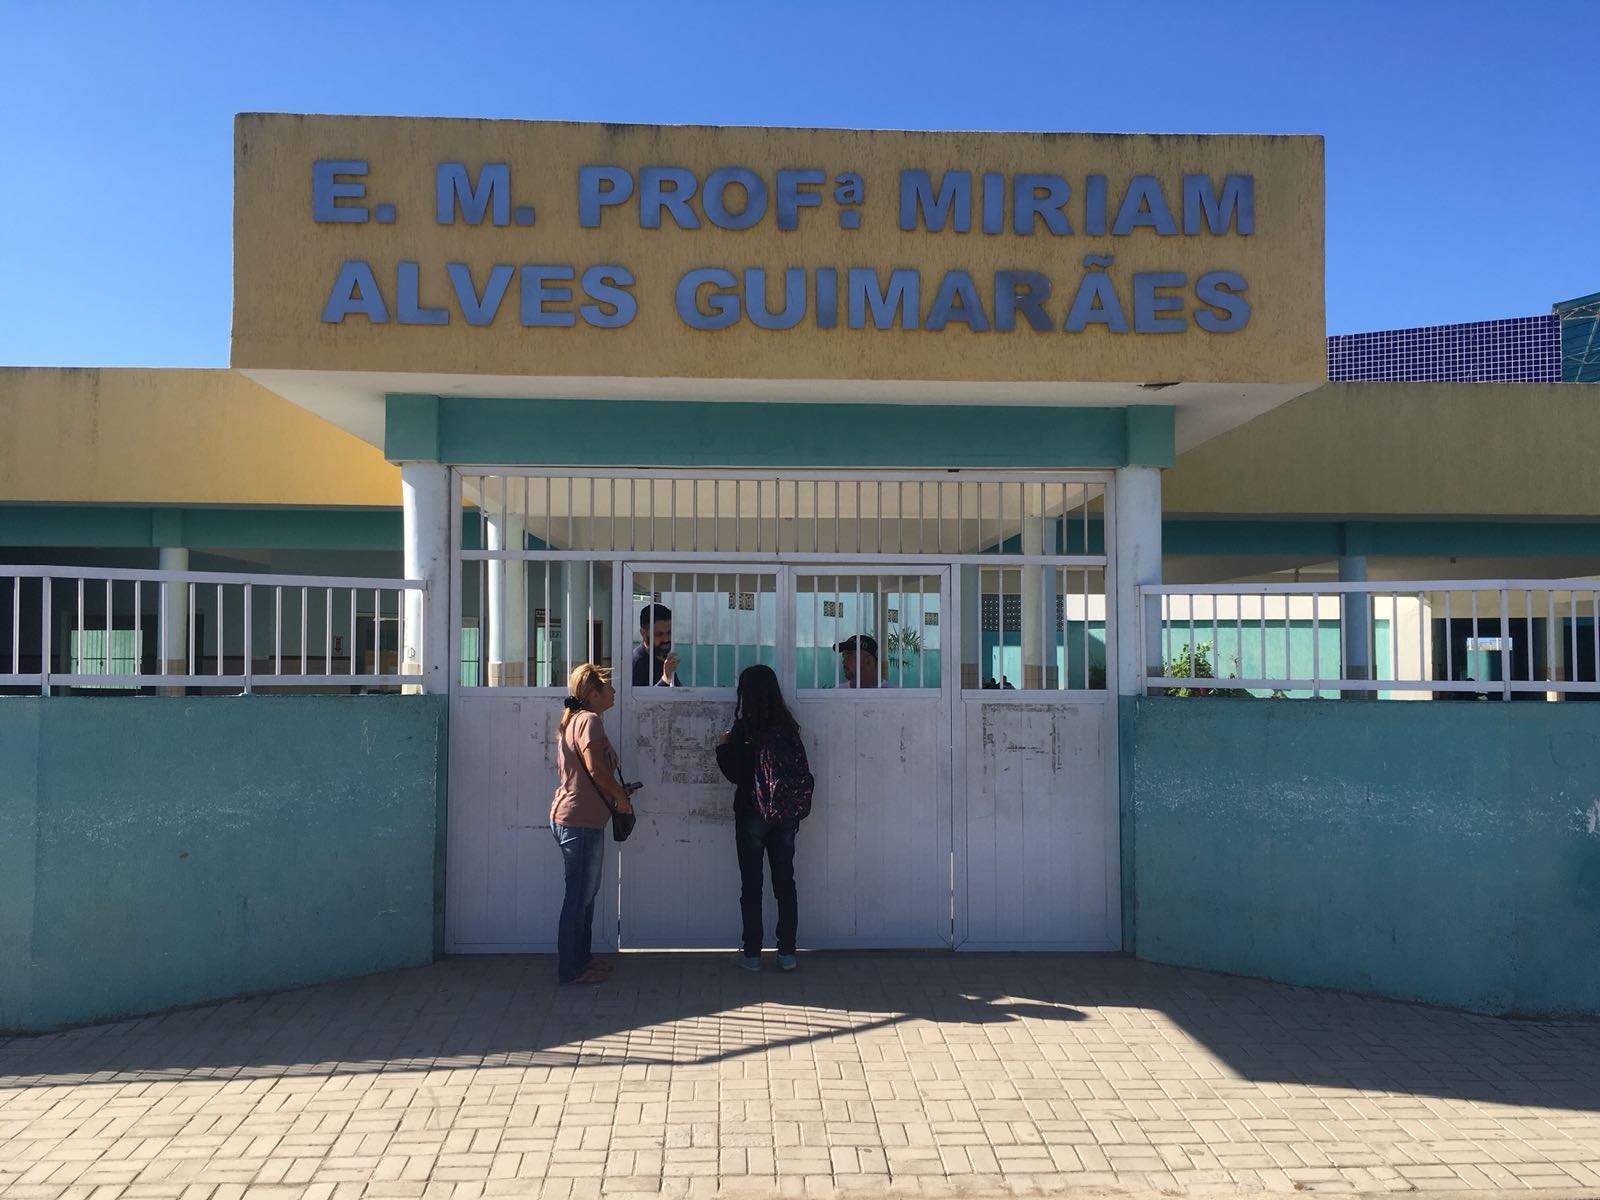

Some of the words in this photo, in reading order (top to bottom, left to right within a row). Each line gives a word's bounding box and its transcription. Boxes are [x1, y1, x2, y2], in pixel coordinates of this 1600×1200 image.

[312, 159, 397, 224] E.
[435, 162, 535, 227] M.
[900, 169, 1256, 236] MIRIAM
[321, 259, 639, 329] ALVES
[674, 253, 1253, 335] GUIMARÃES
